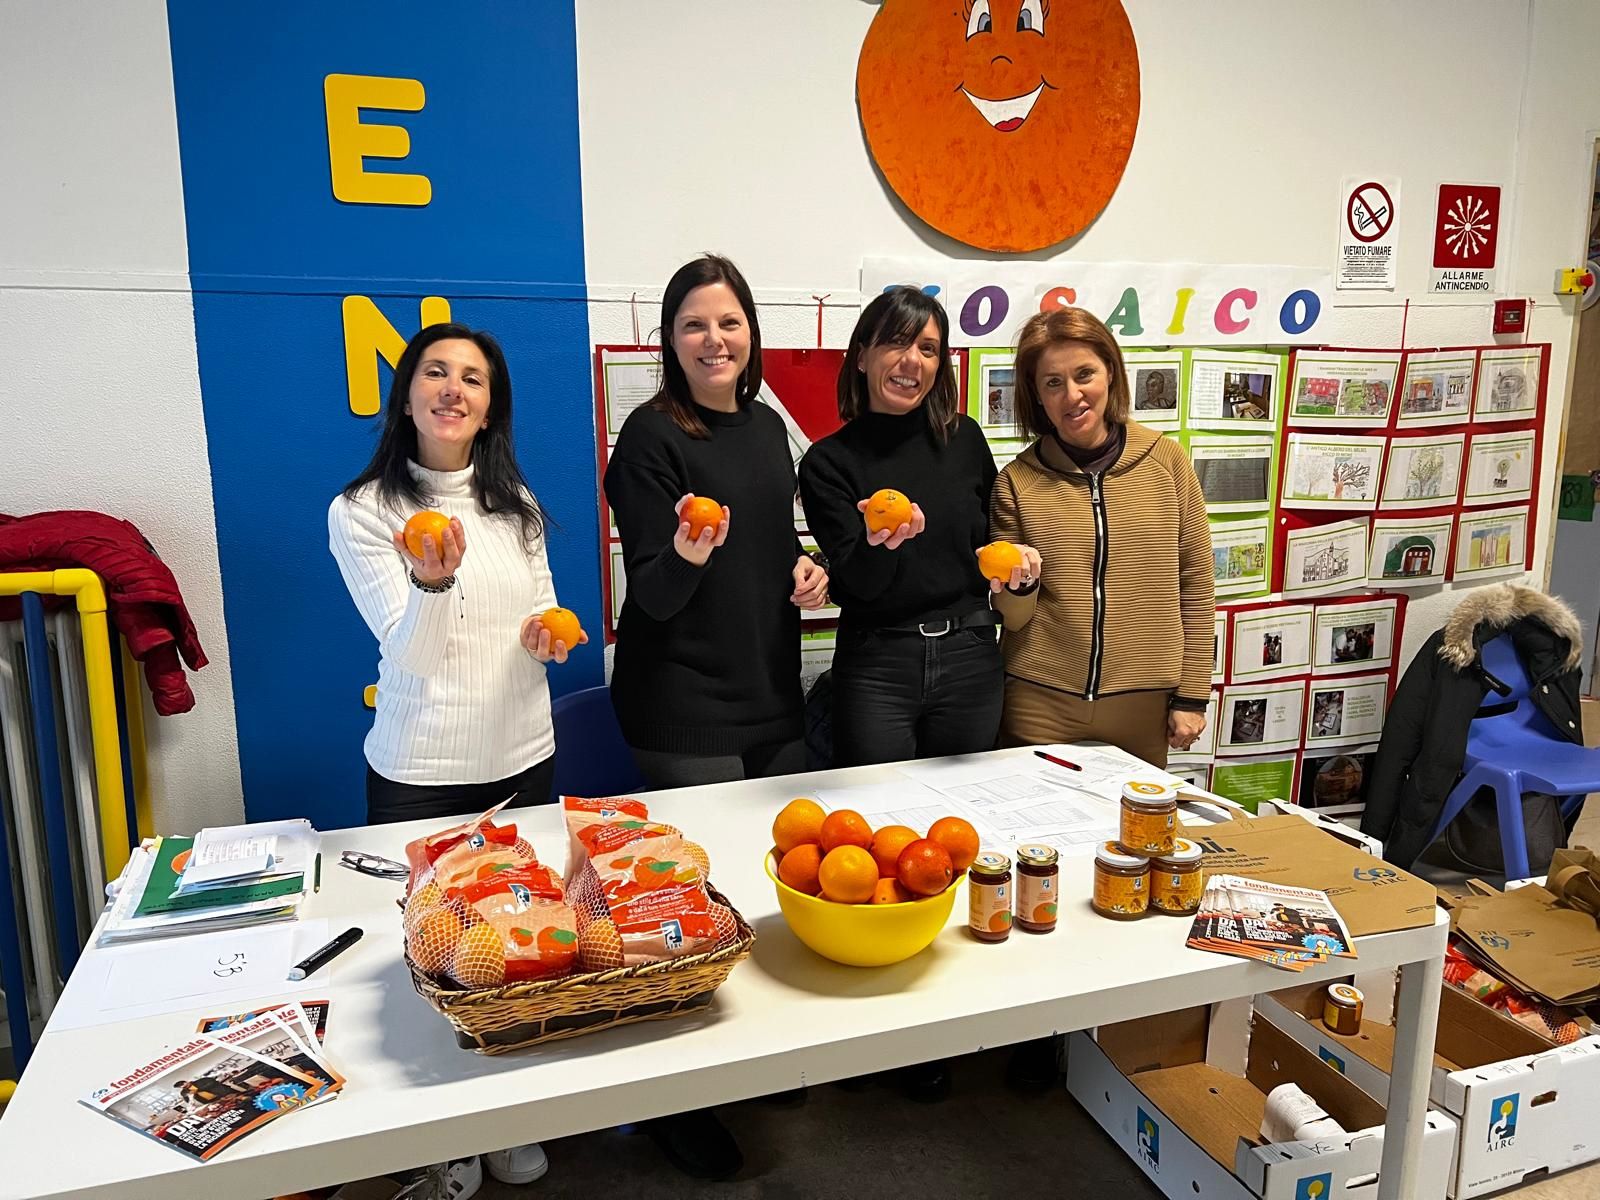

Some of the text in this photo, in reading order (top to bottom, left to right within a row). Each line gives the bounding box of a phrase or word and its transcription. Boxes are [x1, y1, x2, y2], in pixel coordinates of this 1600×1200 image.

[1343, 245, 1392, 256] VIETATO FUMARE
[1442, 271, 1484, 280] ALLARME
[1435, 281, 1489, 290] ANTINCENDIO
[883, 285, 1321, 337] OAICO
[1372, 876, 1408, 887] AIRC
[1243, 880, 1322, 898] fondamentale
[1217, 917, 1238, 928] DA
[110, 1038, 207, 1090] fondamentale
[1486, 1136, 1515, 1153] AIRC
[1138, 1147, 1160, 1174] AIRC
